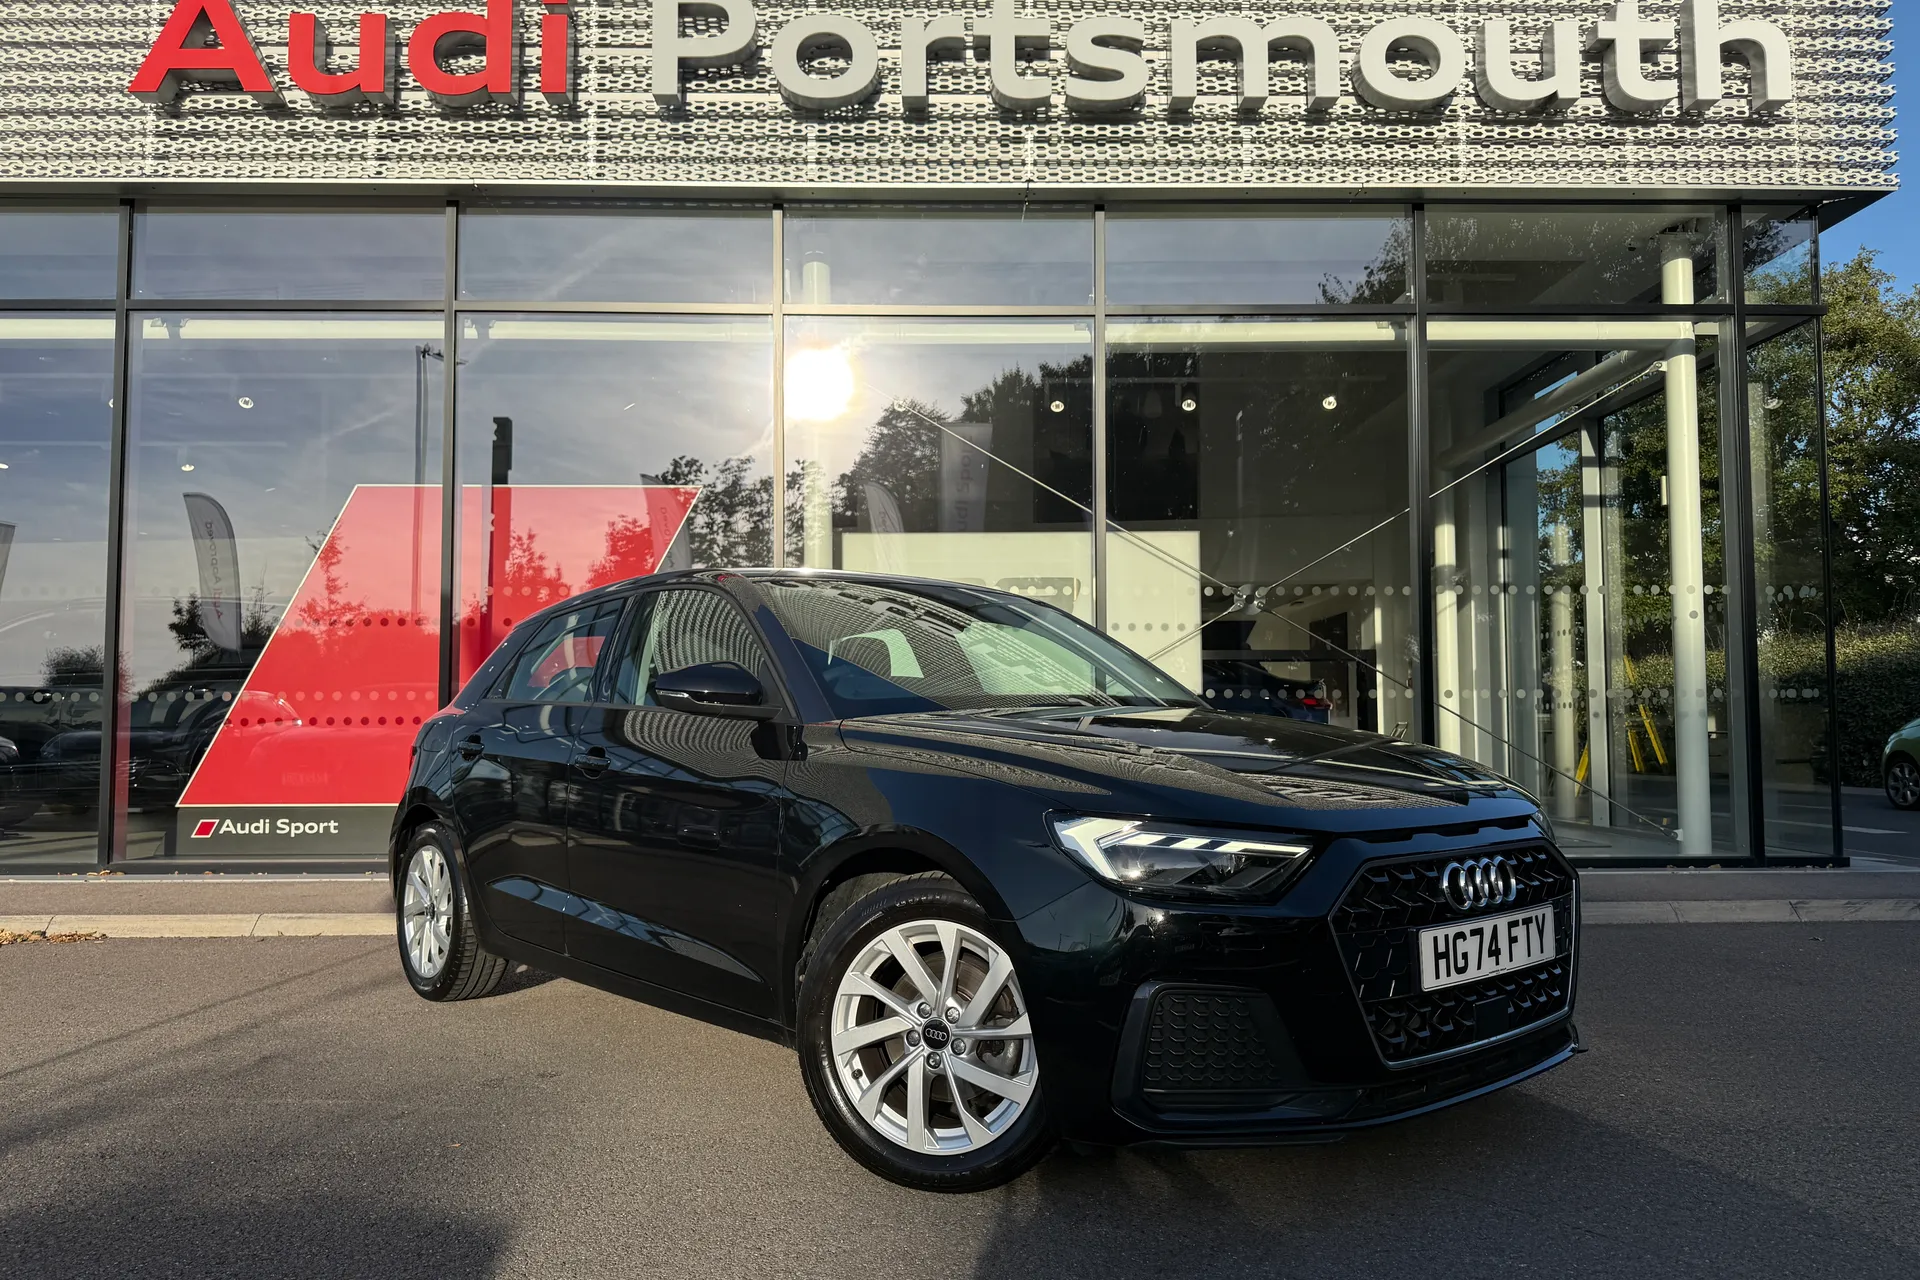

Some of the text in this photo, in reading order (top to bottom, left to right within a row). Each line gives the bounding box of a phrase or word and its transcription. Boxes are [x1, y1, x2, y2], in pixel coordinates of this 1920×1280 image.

[128, 0, 1793, 108] Audi Portsmouth
[219, 818, 339, 838] Audi Sport
[1432, 912, 1546, 981] HG74 FTY
